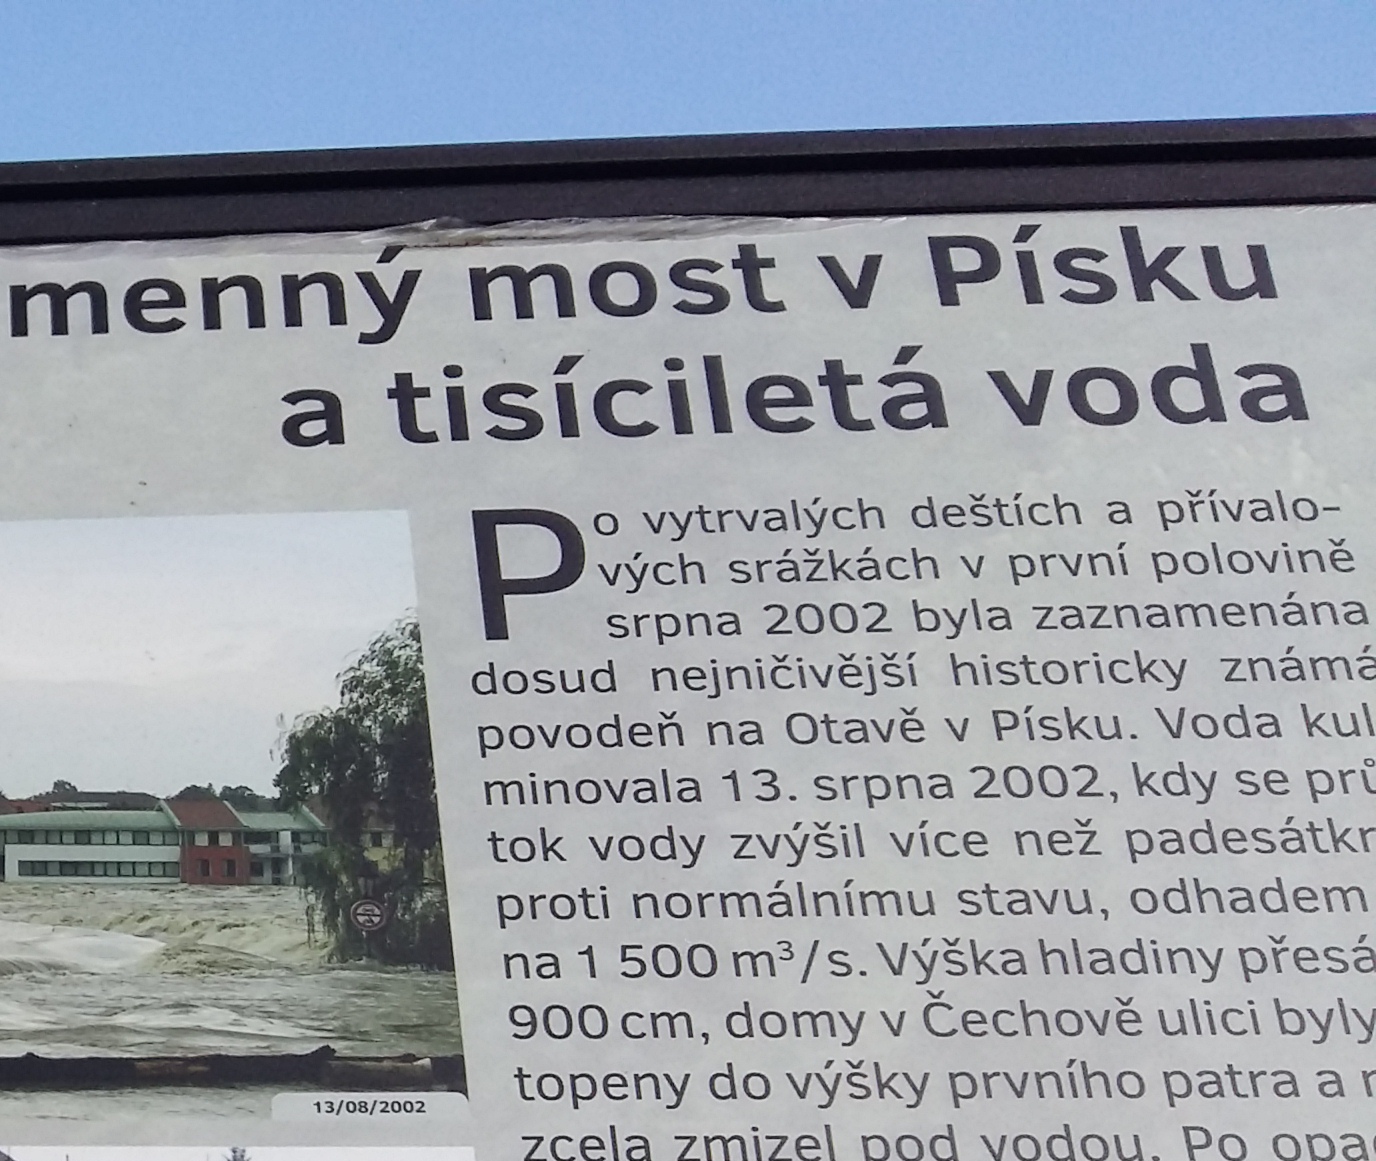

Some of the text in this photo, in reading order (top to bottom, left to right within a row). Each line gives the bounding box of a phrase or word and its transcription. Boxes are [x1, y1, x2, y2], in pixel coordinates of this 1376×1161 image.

[468, 243, 787, 321] most
[817, 254, 883, 309] v
[928, 224, 1278, 306] Písku
[281, 343, 1309, 447] a tisíciletá voda
[642, 497, 885, 542] vytrvalých
[911, 493, 1082, 528] deštích
[1107, 501, 1132, 524] a
[1157, 489, 1340, 531] přívalo-
[598, 538, 1355, 594] vých srážkách v první polovině
[607, 591, 1369, 645] srpna 2002 byla zaznamenána
[472, 660, 617, 695] dosud
[652, 652, 917, 699] nejničivější
[950, 650, 1187, 691] historicky
[478, 711, 684, 758] povodeň
[707, 721, 764, 746] na
[786, 707, 925, 745] Otavě
[944, 718, 969, 741] v
[992, 705, 1138, 741] Písku.
[1154, 704, 1282, 739] Voda
[484, 769, 702, 805] minovala
[722, 769, 797, 801] 13.
[814, 774, 954, 808] srpna
[970, 764, 1118, 803] 2002,
[1132, 762, 1217, 804] kdy
[1235, 770, 1290, 795] se
[487, 827, 567, 862] tok
[588, 825, 705, 868] vody
[730, 821, 865, 867] zvýšil
[889, 820, 989, 857] více
[1015, 818, 1102, 856] než
[497, 877, 1368, 929] proti normálnímu stavu, odhadem
[504, 953, 561, 979] na
[876, 938, 1027, 985] Výška
[1038, 938, 1223, 983] hladiny
[509, 1004, 608, 1039] 900
[621, 1012, 709, 1045] cm,
[726, 1001, 865, 1046] domy
[880, 1011, 906, 1037] v
[923, 990, 1143, 1037] Čechově
[1158, 999, 1260, 1036] ulici
[313, 1100, 426, 1115] 13/08/2002
[514, 1067, 691, 1110] topeny
[709, 1062, 771, 1100] do
[786, 1060, 930, 1109] výšky
[949, 1059, 1145, 1108] prvního
[1163, 1064, 1300, 1107] patra
[1316, 1070, 1345, 1098] a
[980, 1124, 1160, 1161] vodou.
[1182, 1126, 1247, 1161] Po
